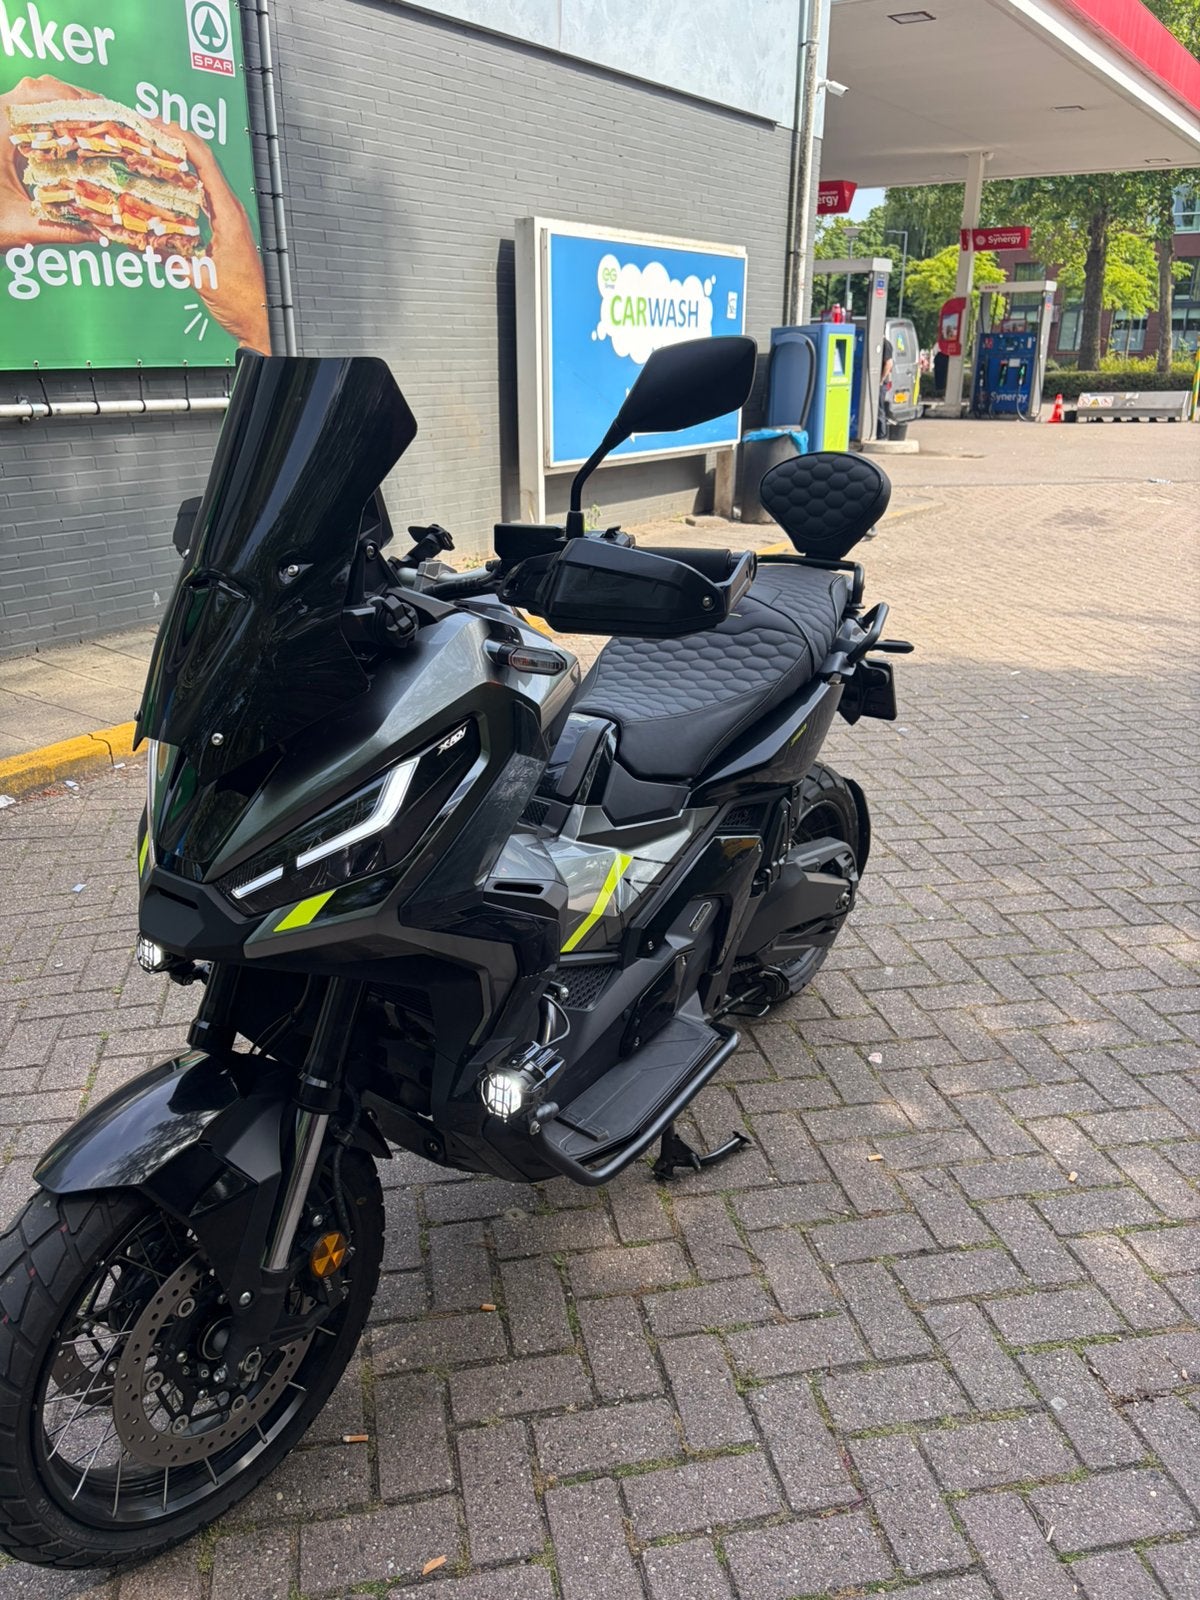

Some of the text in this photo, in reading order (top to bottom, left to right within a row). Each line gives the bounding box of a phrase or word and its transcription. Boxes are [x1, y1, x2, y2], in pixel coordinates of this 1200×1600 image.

[0, 0, 115, 66] kker
[194, 54, 233, 72] SPAR
[135, 81, 227, 146] snel
[987, 235, 1021, 245] Synergy
[5, 237, 218, 300] genieten
[610, 295, 698, 327] CARWASH
